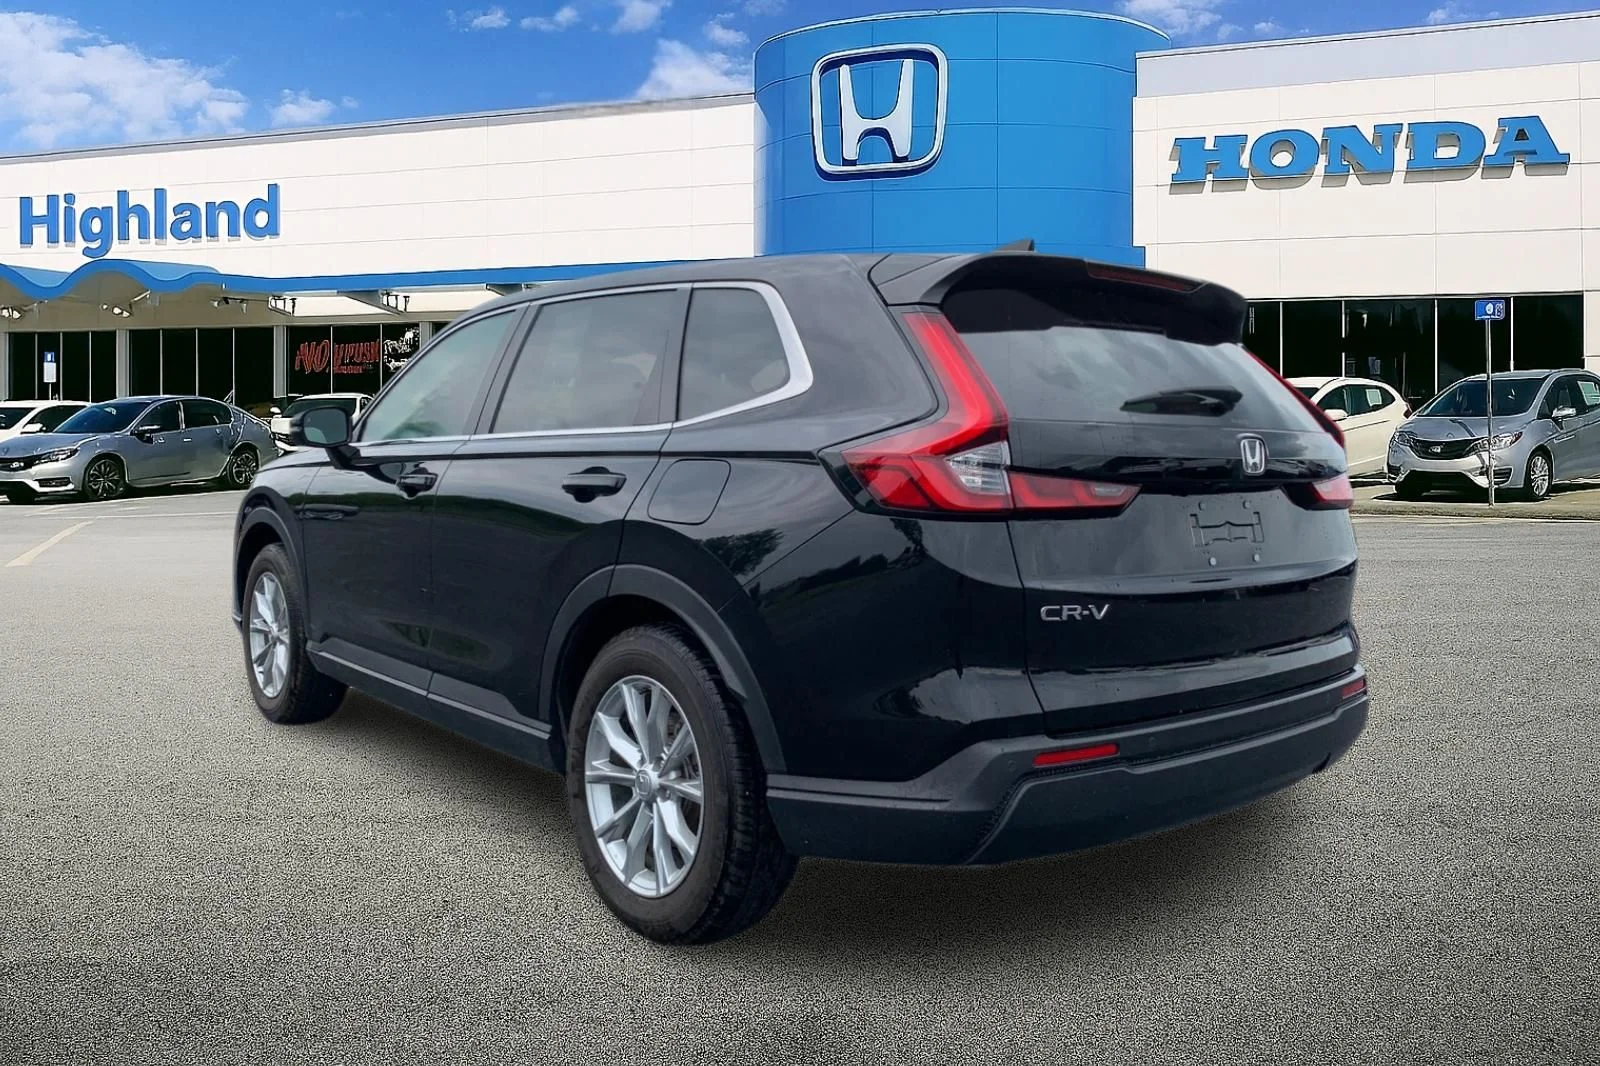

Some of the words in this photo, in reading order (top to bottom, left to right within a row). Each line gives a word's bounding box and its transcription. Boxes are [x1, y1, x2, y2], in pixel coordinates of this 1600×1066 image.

[1171, 115, 1570, 183] HONDA
[19, 183, 281, 259] Highland
[1040, 604, 1110, 621] CR-V
